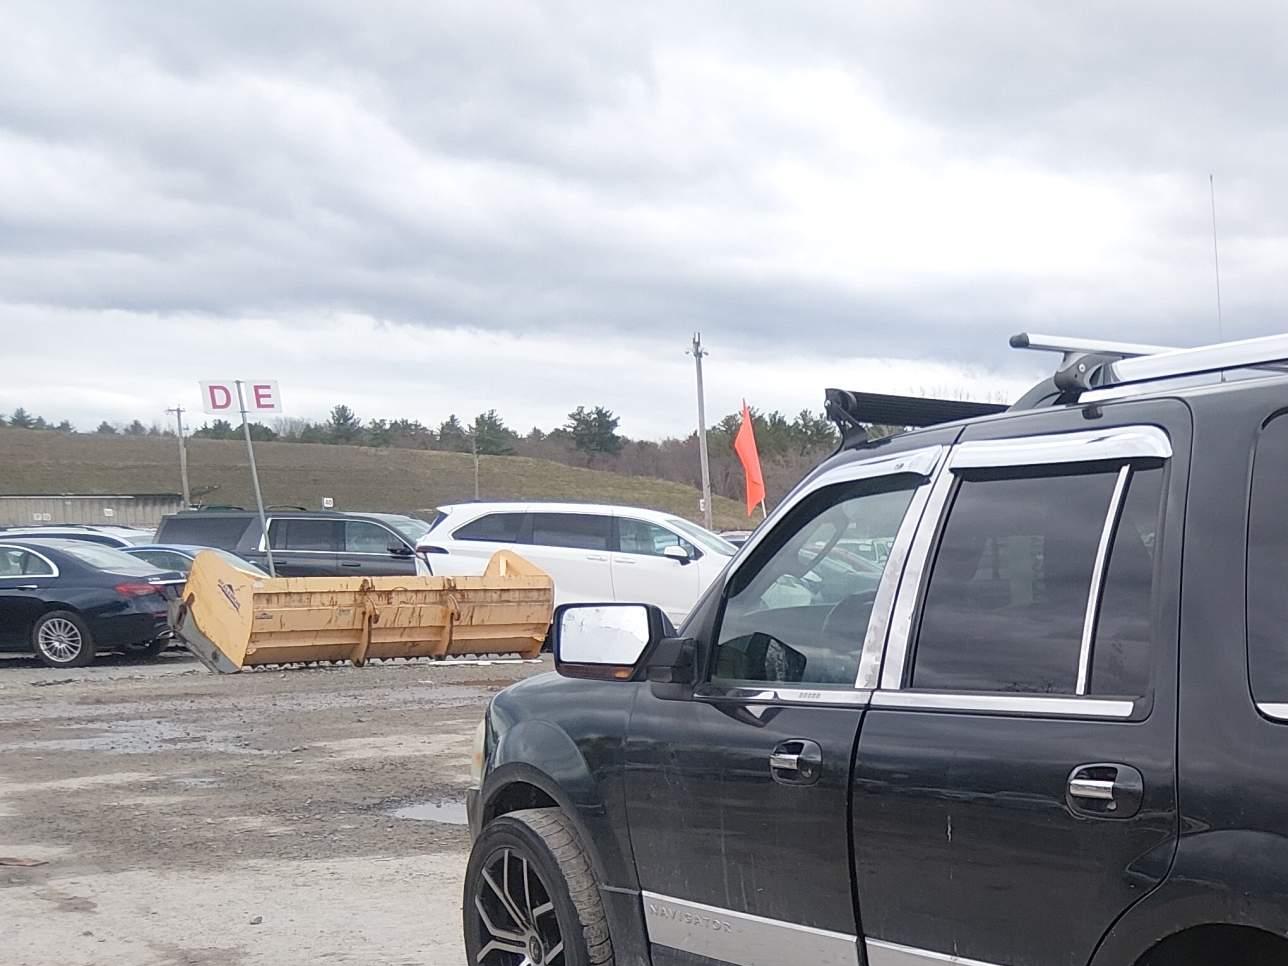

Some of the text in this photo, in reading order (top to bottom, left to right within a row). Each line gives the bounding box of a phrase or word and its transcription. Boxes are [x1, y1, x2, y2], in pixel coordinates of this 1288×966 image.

[208, 385, 232, 409] D
[253, 385, 275, 409] E
[648, 903, 733, 934] NAVIGATOR
